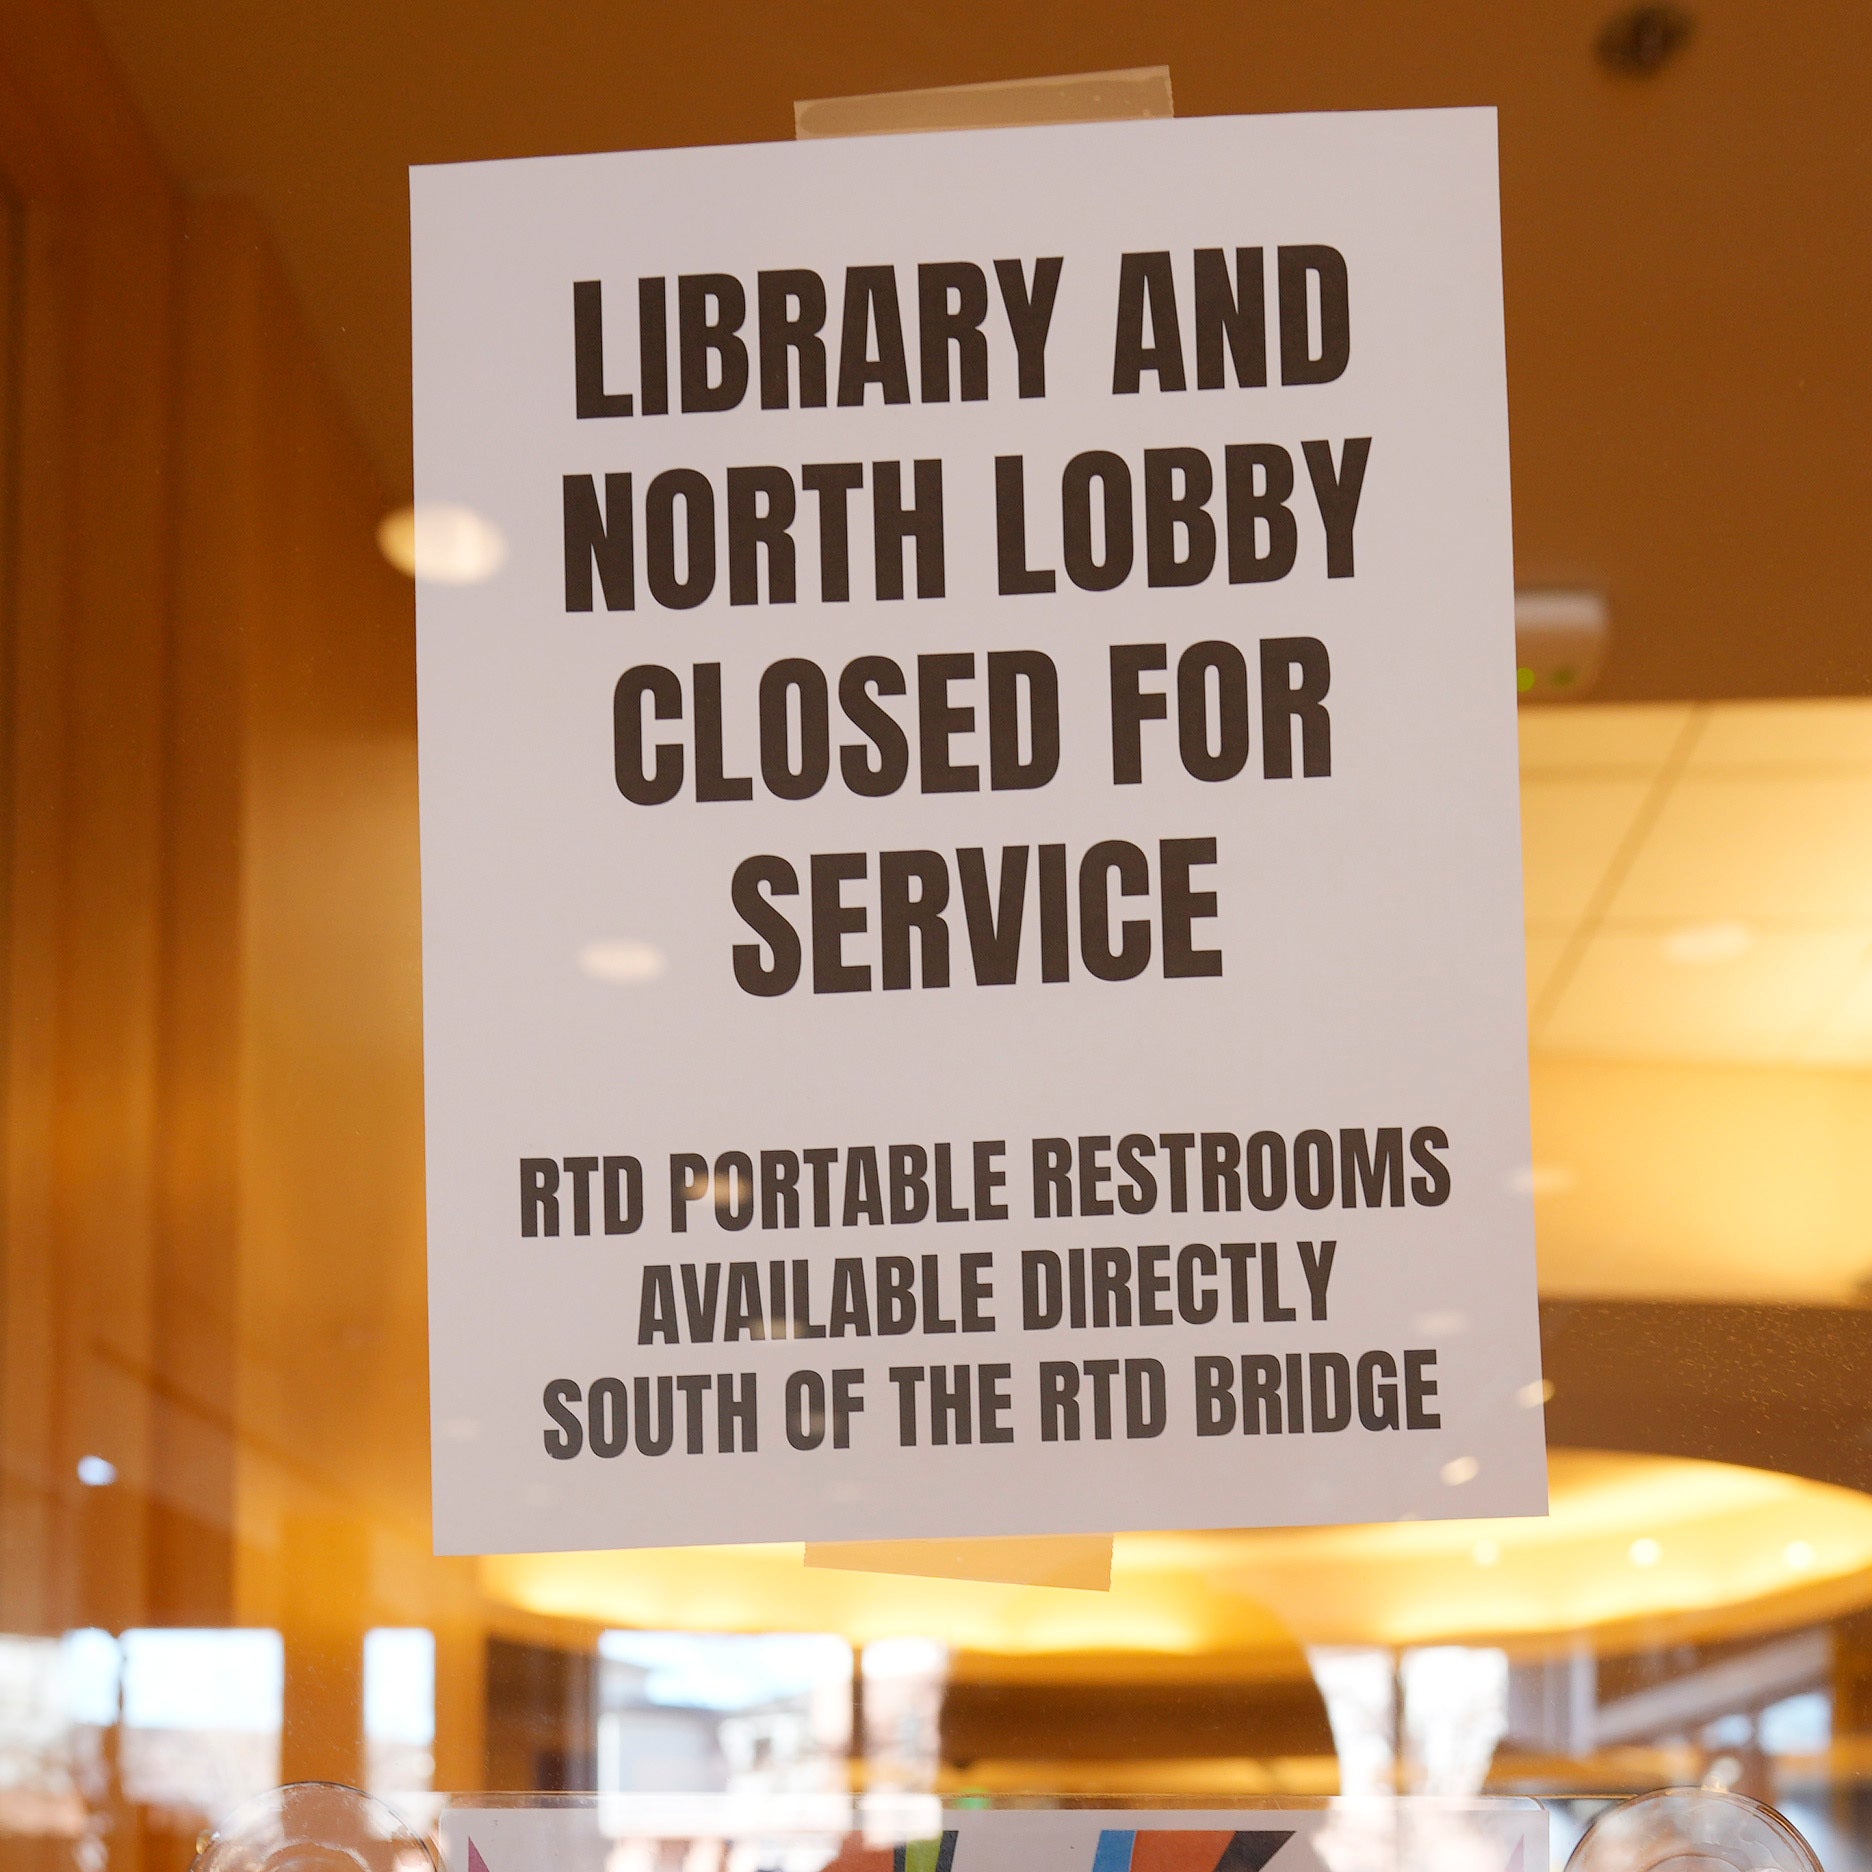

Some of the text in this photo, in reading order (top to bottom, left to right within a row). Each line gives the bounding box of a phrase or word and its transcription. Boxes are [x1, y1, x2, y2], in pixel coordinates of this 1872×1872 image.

[572, 243, 1351, 420] LIBRARY AND
[562, 436, 1373, 613] NORTH LOBBY
[612, 635, 1332, 807] CLOSED FOR
[730, 836, 1223, 998] SERVICE
[519, 1125, 1452, 1239] RTD PORTABLE RESTROOMS
[637, 1239, 1338, 1346] AVAILABLE DIRECTLY
[542, 1348, 1442, 1461] SOUTH OF THE RTD BRIDGE
